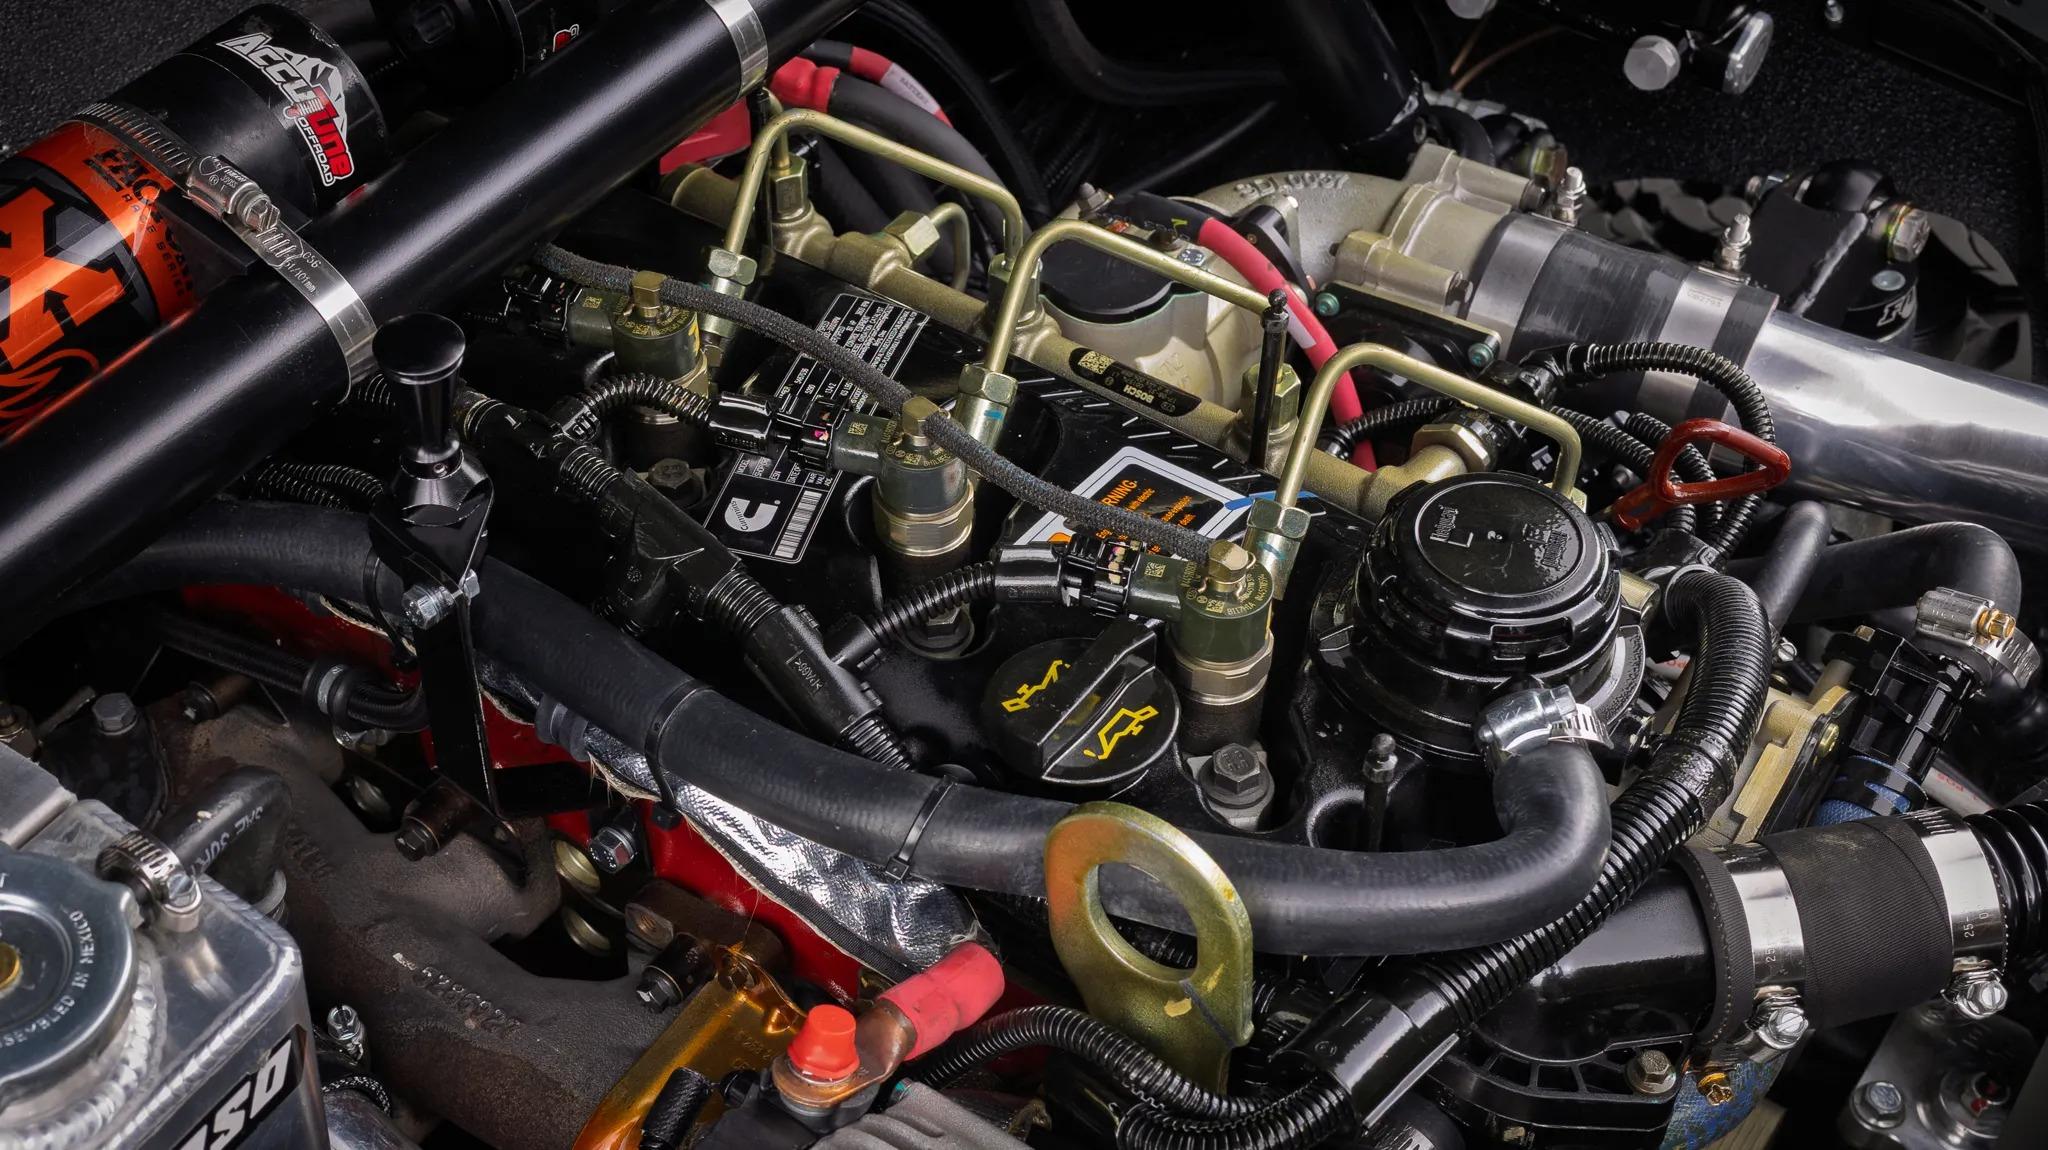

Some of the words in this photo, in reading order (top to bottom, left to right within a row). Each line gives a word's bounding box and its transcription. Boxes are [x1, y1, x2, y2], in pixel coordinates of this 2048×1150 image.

[298, 117, 334, 184] OFFROAD
[1123, 384, 1155, 405] BOSCH
[1101, 479, 1137, 506] RNING
[69, 910, 95, 965] MEXICO
[72, 971, 91, 990] IN
